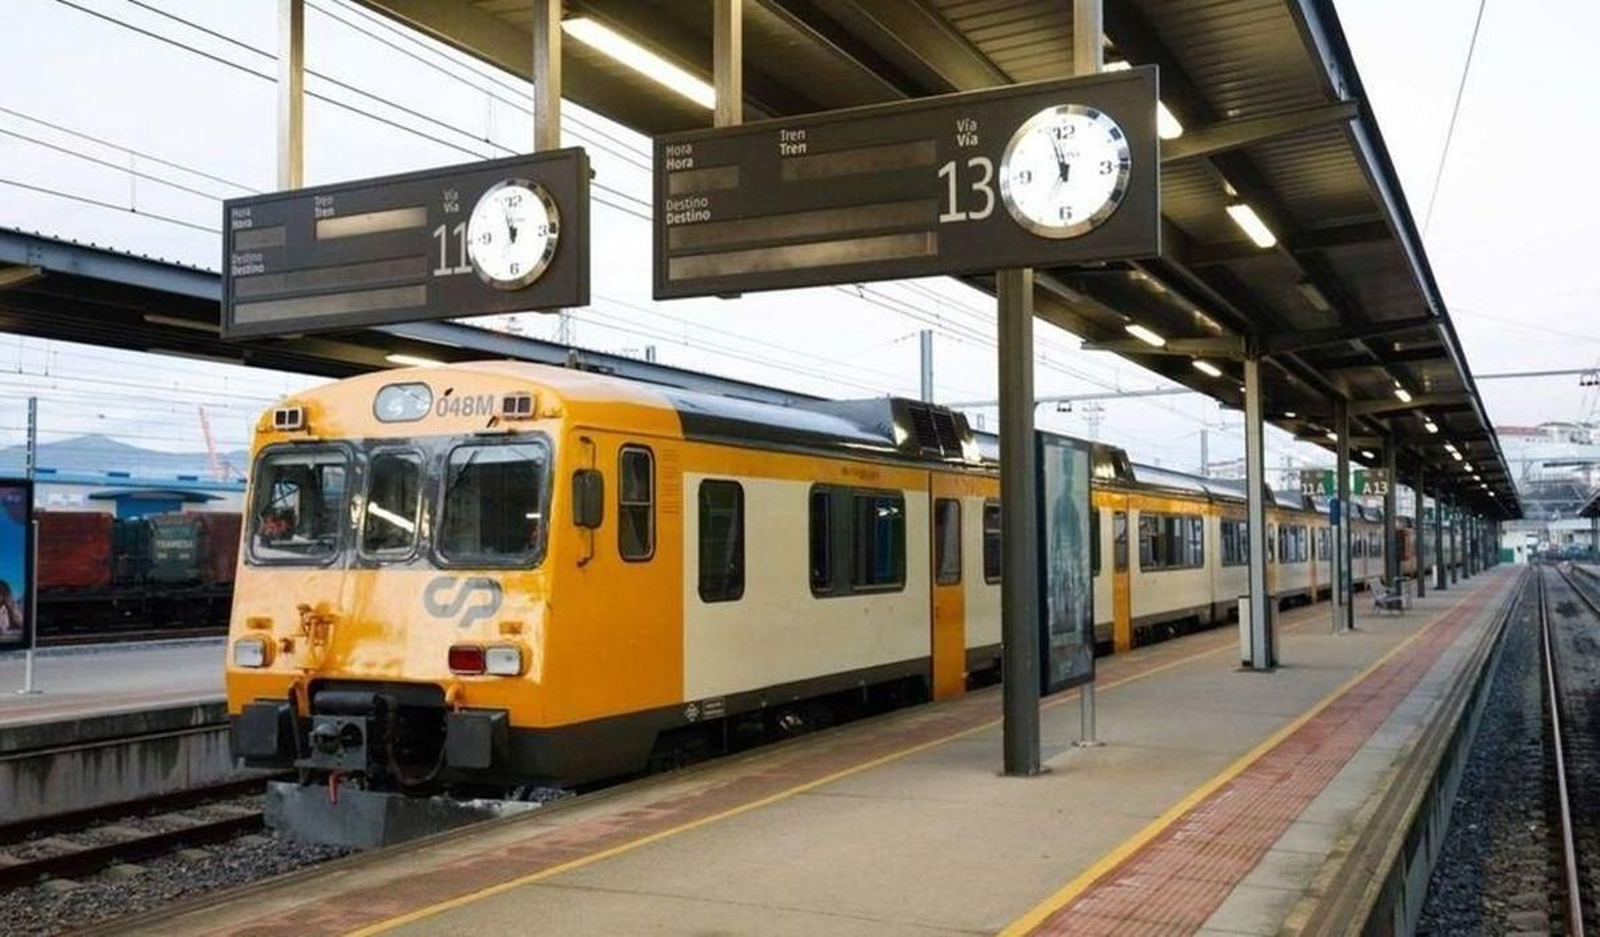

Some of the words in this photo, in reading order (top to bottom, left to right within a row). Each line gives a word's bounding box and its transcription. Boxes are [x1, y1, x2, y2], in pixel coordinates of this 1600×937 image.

[956, 117, 978, 132] Vía
[780, 129, 806, 142] Tren
[956, 132, 979, 147] Vía
[1052, 125, 1076, 141] 12
[666, 144, 693, 157] Hora
[780, 143, 807, 156] Tren
[666, 157, 694, 170] Hora
[1099, 160, 1114, 175] 3
[1018, 169, 1033, 185] 9
[937, 156, 995, 224] 13
[504, 195, 523, 208] 12
[666, 196, 709, 212] Destino
[314, 206, 335, 218] Tren
[666, 209, 711, 225] Destino
[1058, 205, 1073, 221] 6
[537, 224, 549, 238] 3
[481, 232, 493, 246] 9
[433, 221, 473, 277] 11
[509, 261, 520, 276] 6
[436, 395, 495, 417] 048M
[1301, 483, 1314, 495] 11
[1316, 482, 1325, 495] A
[1363, 482, 1372, 495] A
[1373, 481, 1389, 495] 13
[424, 576, 503, 627] CP
